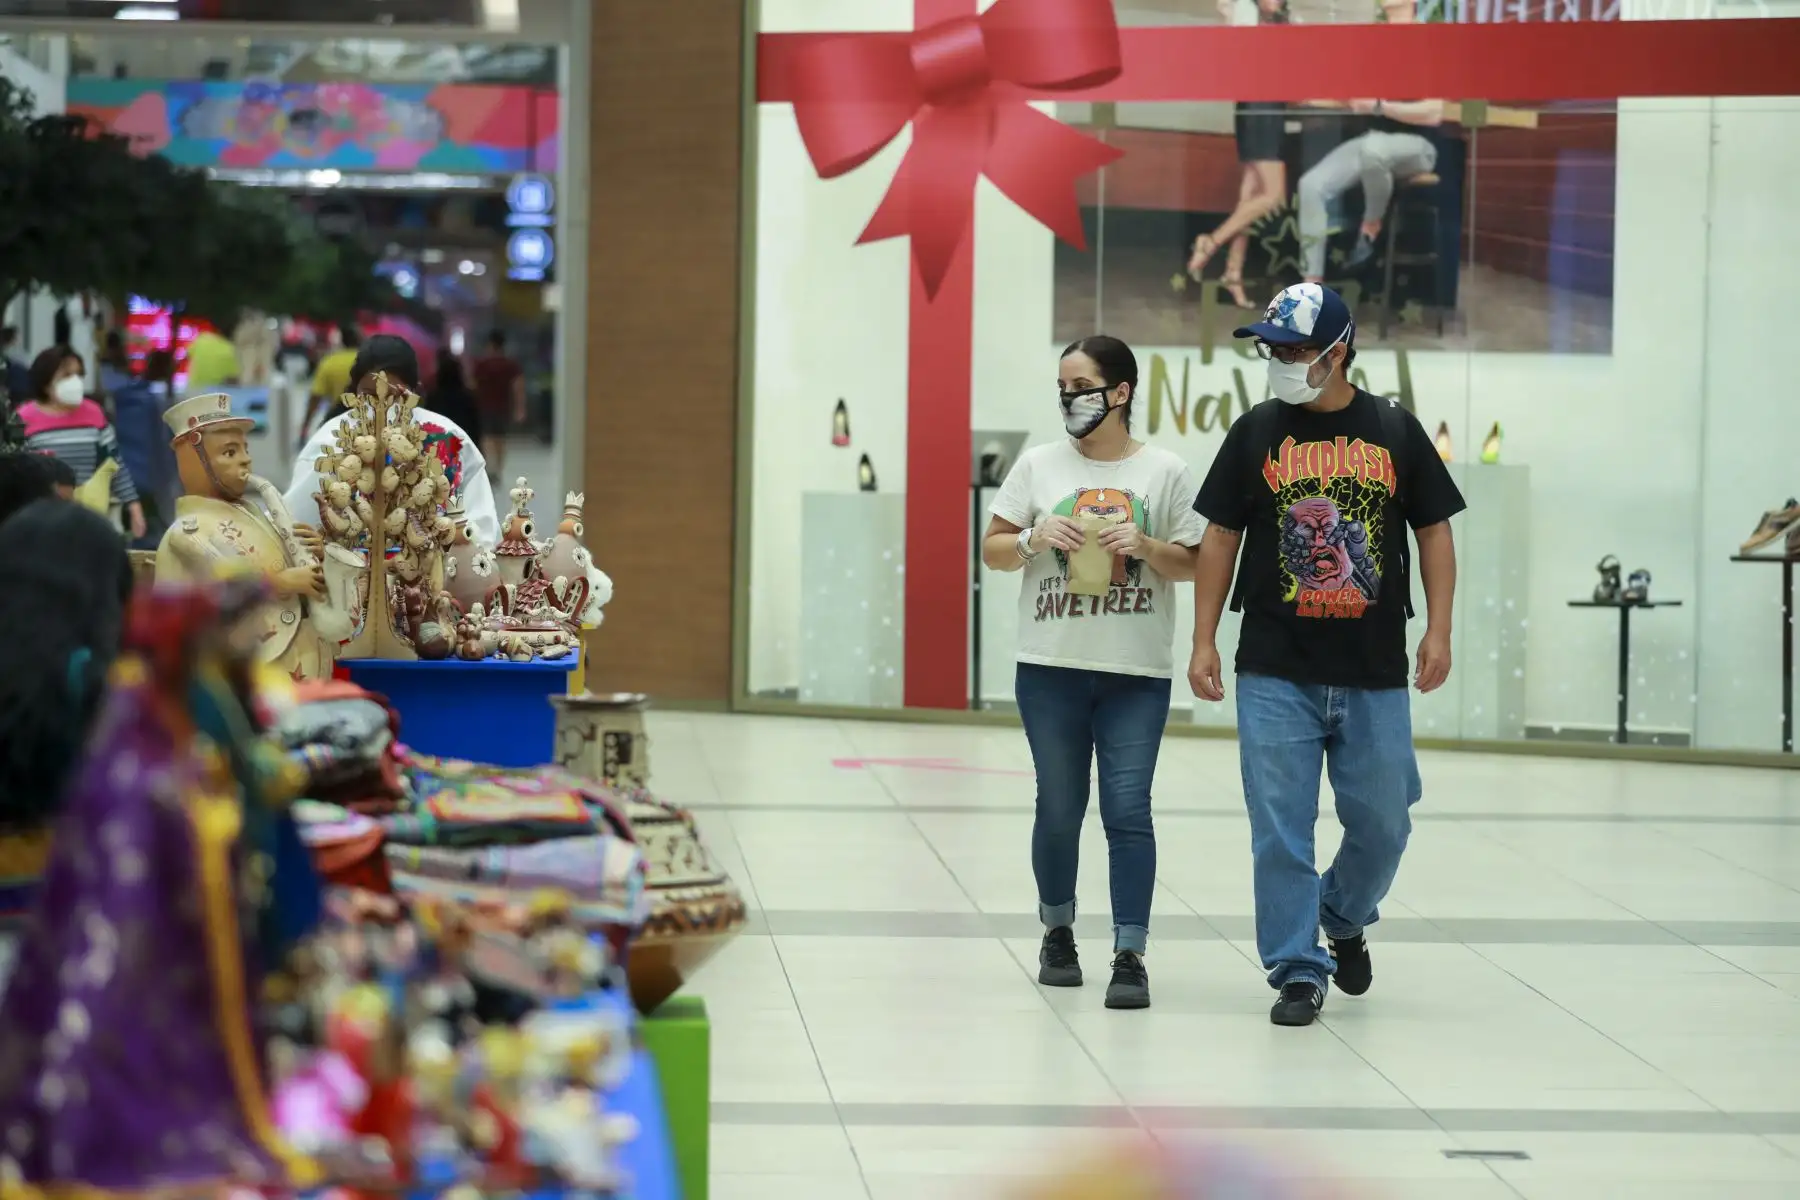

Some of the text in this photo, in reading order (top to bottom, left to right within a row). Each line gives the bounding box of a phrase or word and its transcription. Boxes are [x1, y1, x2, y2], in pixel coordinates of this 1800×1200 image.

[1263, 435, 1397, 498] WHIPLASH
[1034, 592, 1083, 622] SAVE
[1300, 588, 1362, 605] POWER
